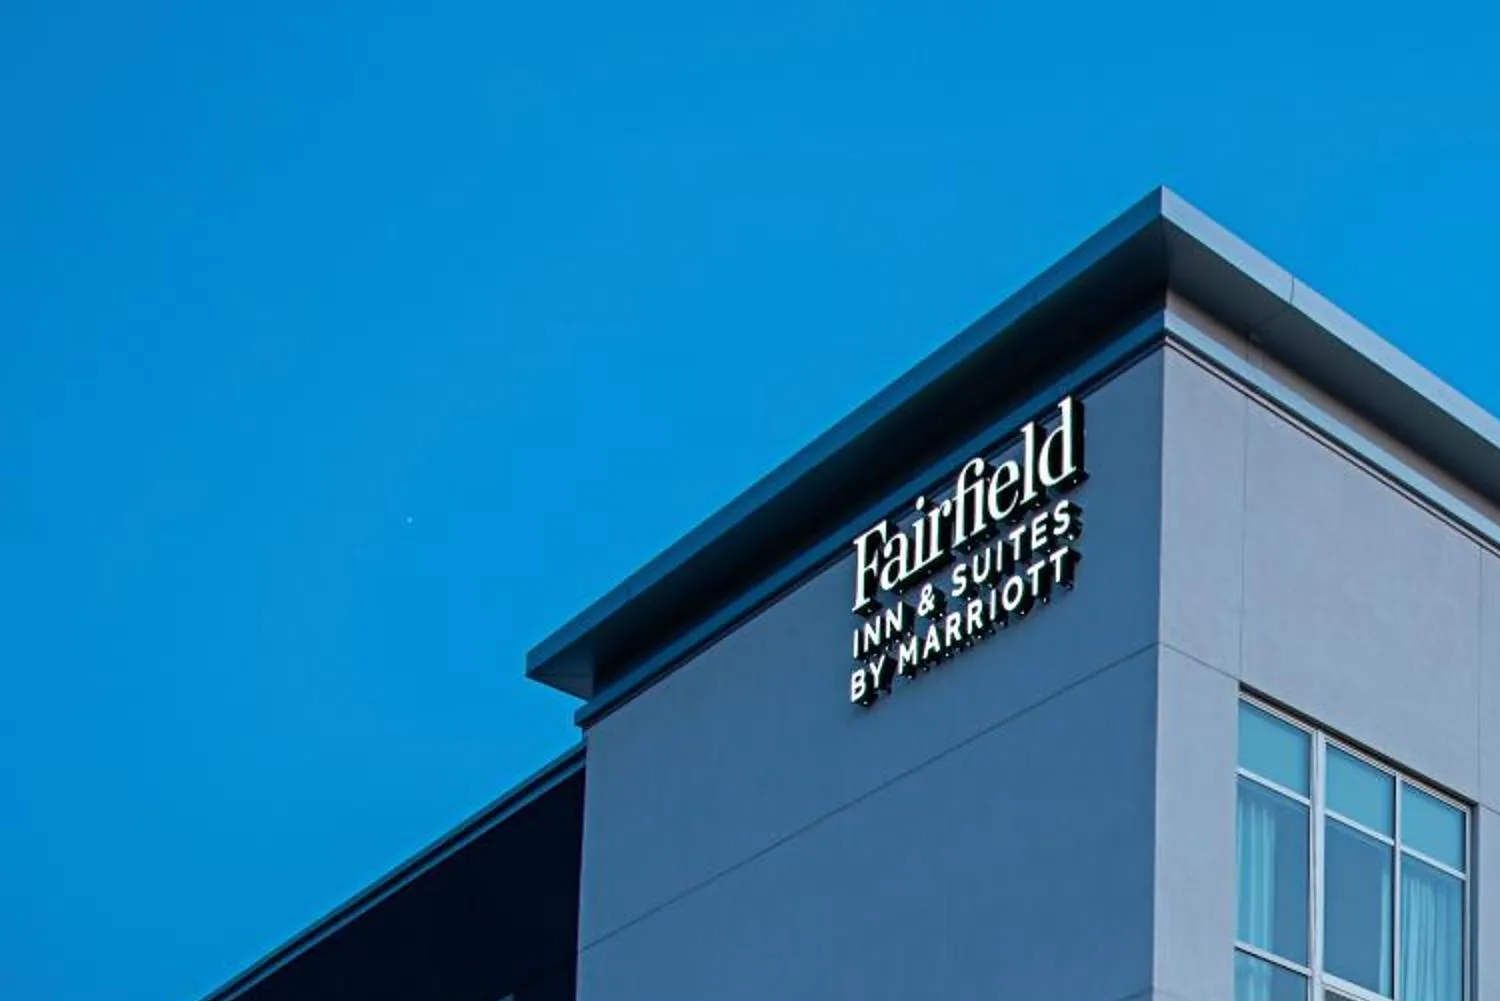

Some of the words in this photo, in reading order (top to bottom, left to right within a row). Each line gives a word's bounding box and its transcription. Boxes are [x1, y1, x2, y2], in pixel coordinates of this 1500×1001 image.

[851, 395, 1078, 612] Fairfield
[852, 602, 903, 659] INN
[916, 583, 936, 617] &
[951, 499, 1073, 598] SUITES
[851, 655, 886, 703] BY
[898, 546, 1069, 674] MARRIOTT
